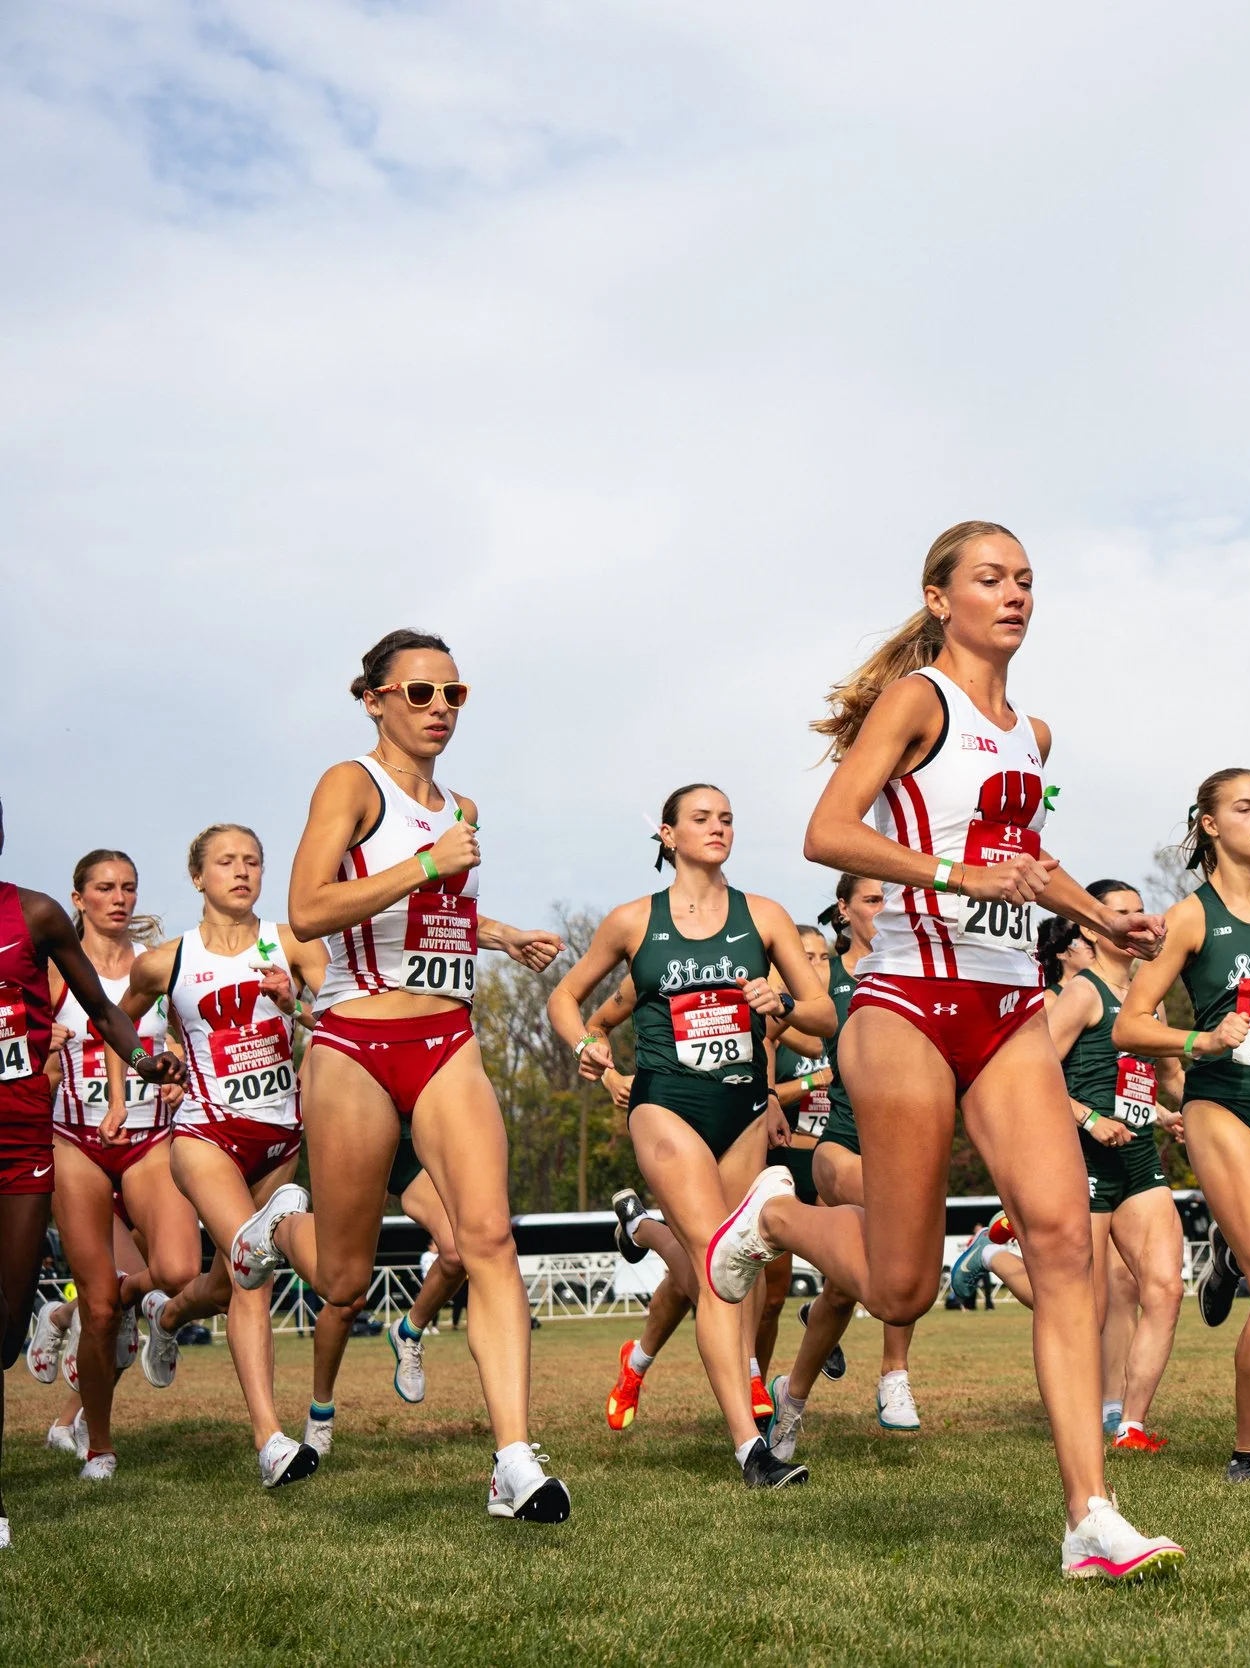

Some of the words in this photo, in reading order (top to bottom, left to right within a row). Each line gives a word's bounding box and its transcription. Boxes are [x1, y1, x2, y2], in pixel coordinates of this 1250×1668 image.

[422, 914, 471, 928] NUTTYCOMBE
[965, 897, 1031, 941] 2031
[427, 927, 466, 939] WISCONSIN
[419, 938, 471, 951] INVITATIONAL
[406, 955, 474, 991] 2019
[684, 1004, 738, 1020] NUTTYCOMBE
[691, 1014, 732, 1028] WISCONSIN
[687, 1022, 740, 1038] INVITATIONAL
[224, 1034, 279, 1055] NUTTYCOMBE
[231, 1045, 275, 1062] WISCONSIN
[691, 1038, 740, 1066] 798
[228, 1052, 283, 1073] INVITATIONAL
[224, 1065, 291, 1104] 2020
[1123, 1101, 1150, 1125] 799
